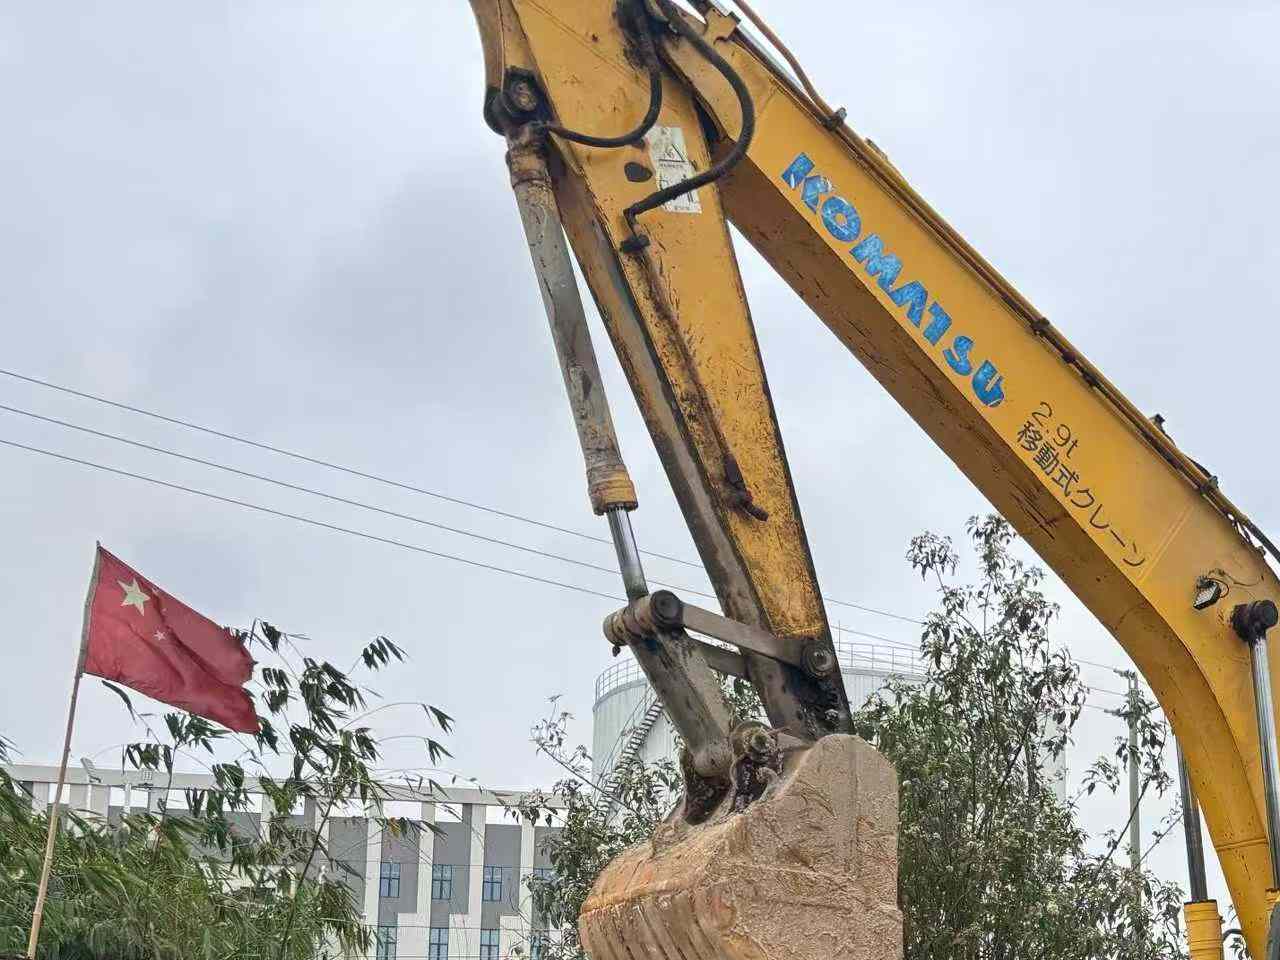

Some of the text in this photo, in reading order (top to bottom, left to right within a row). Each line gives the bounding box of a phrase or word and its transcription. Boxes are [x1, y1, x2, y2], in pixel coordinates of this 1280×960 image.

[781, 152, 1005, 408] KOMATSU
[1017, 421, 1145, 567] 移動式クレーン
